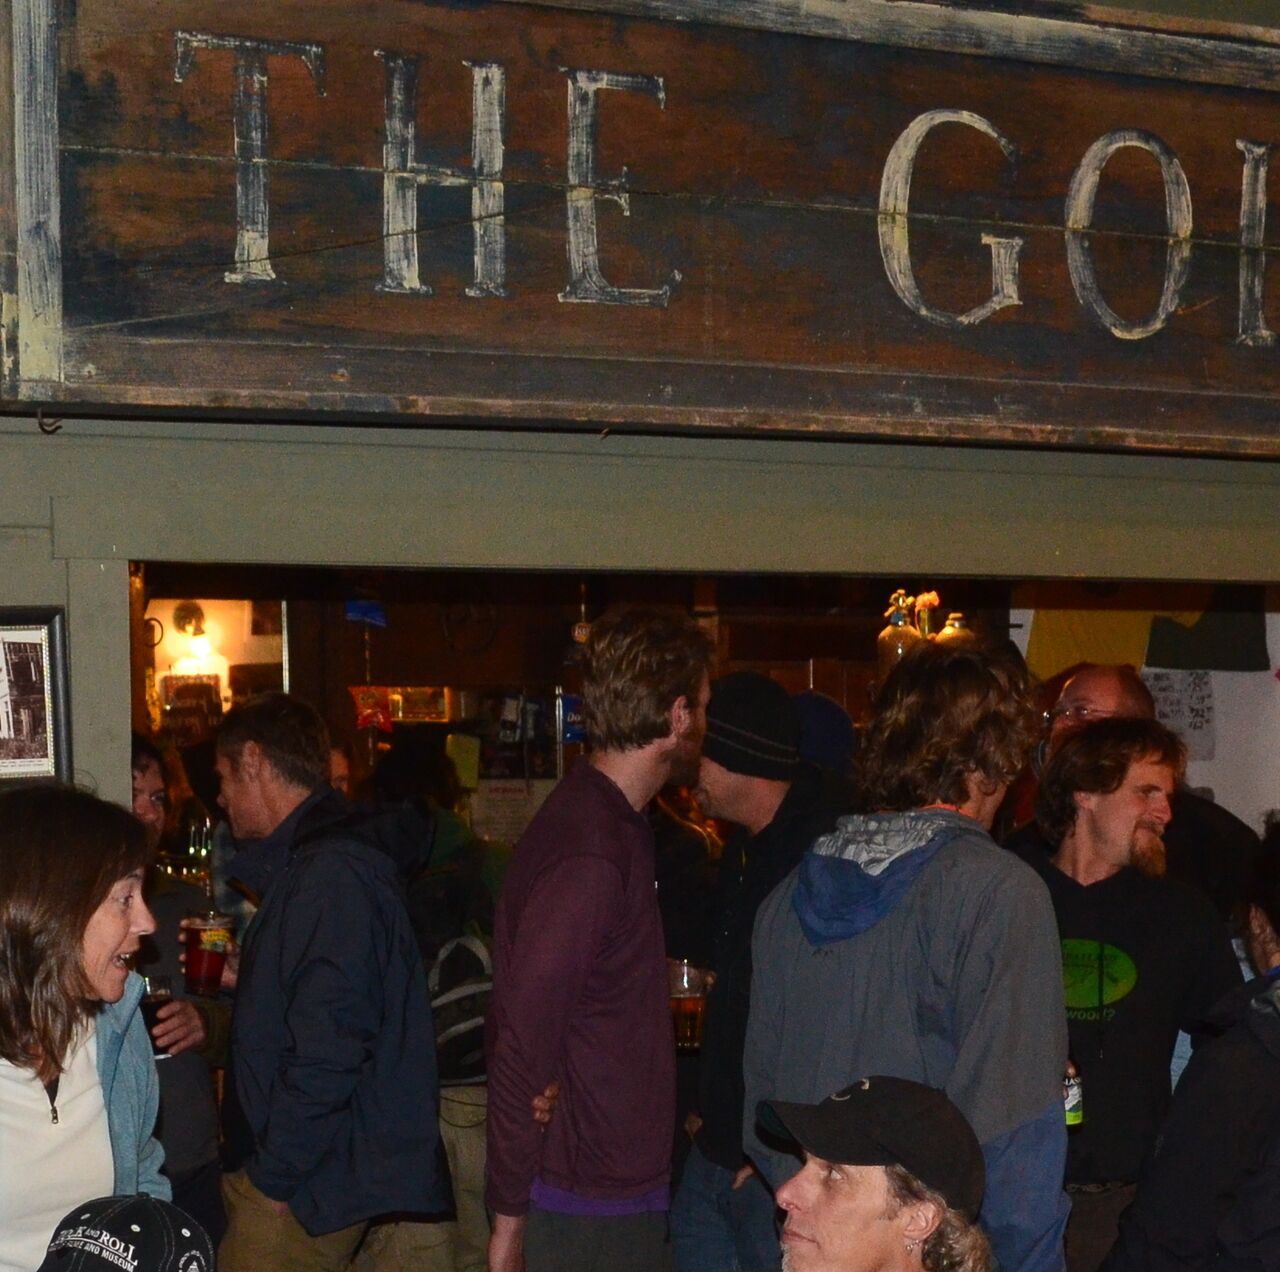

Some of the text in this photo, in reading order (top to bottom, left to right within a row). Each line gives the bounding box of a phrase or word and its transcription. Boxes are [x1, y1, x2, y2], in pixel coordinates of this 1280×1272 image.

[173, 29, 683, 308] THE
[83, 1243, 101, 1255] AND
[98, 1230, 138, 1266] ROLL
